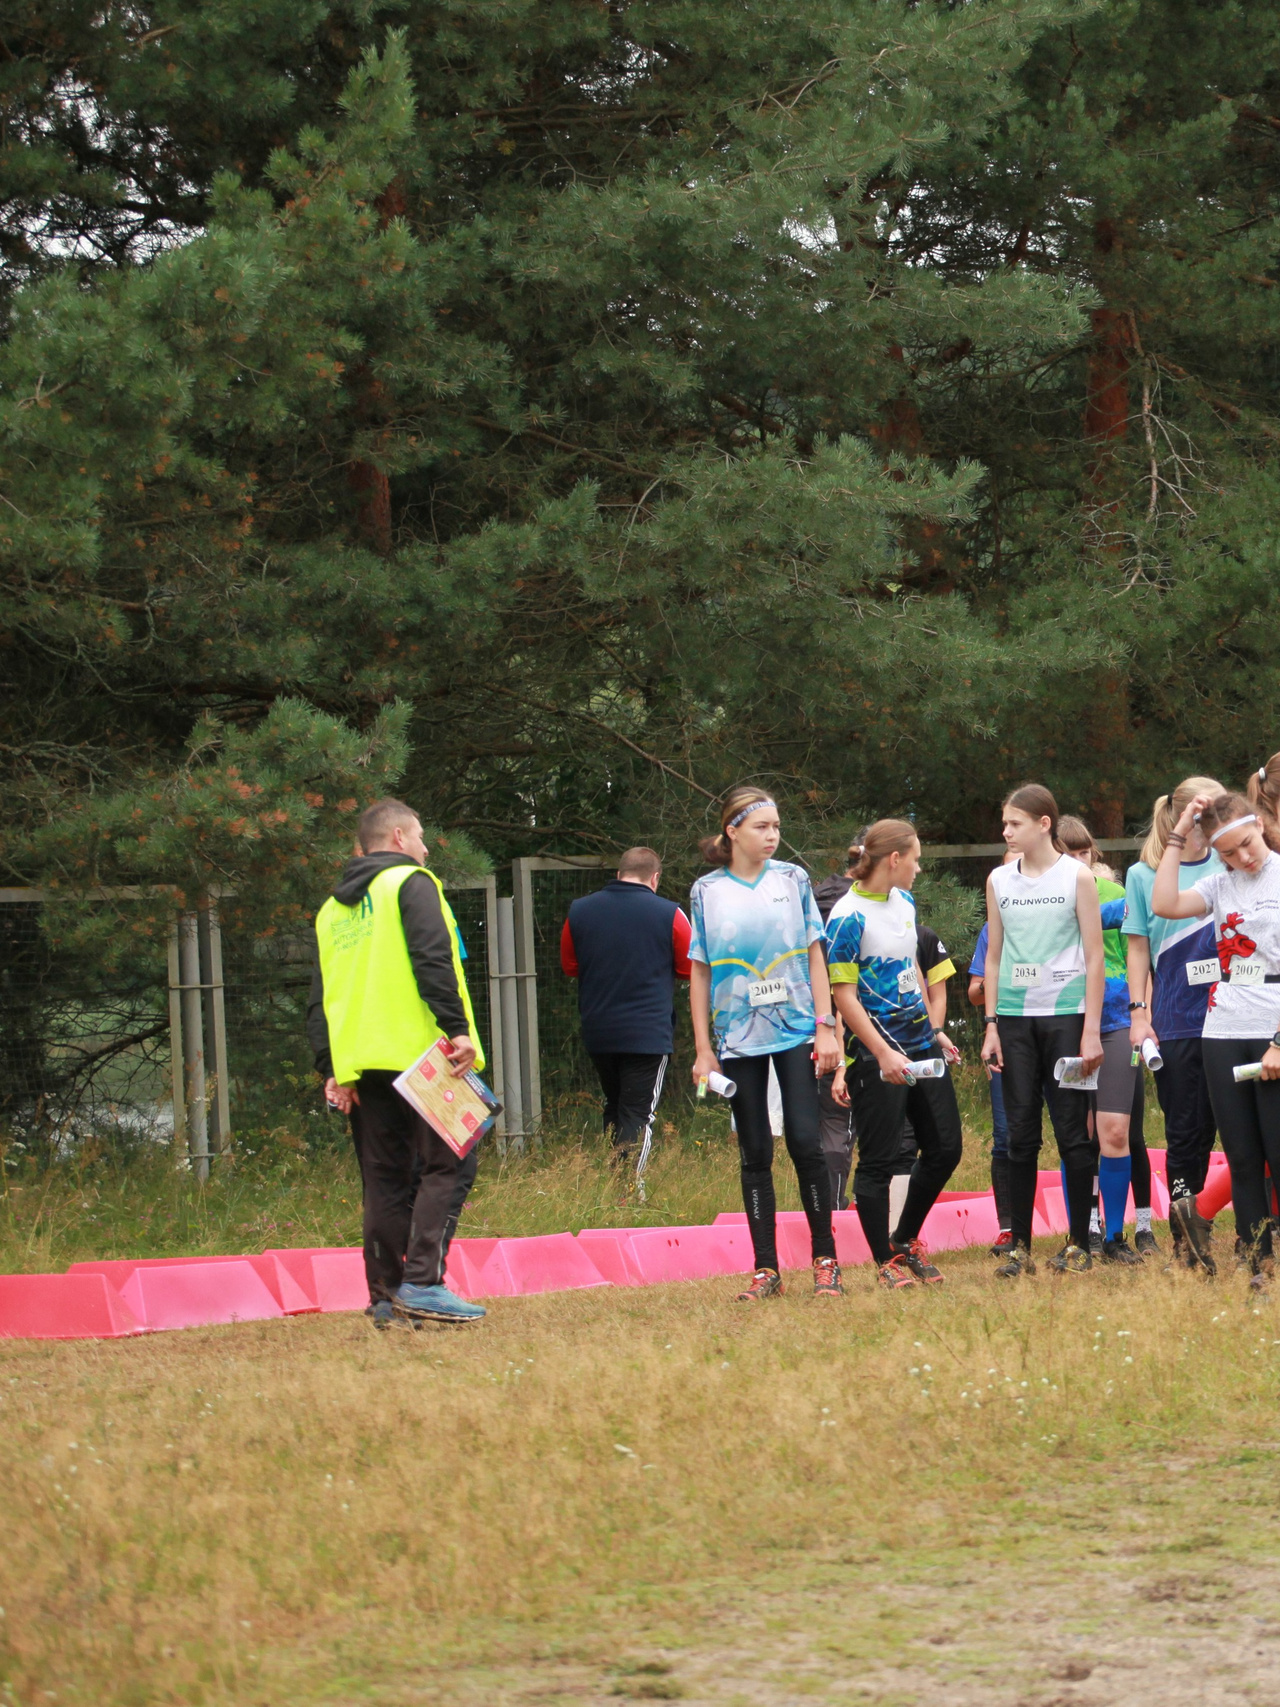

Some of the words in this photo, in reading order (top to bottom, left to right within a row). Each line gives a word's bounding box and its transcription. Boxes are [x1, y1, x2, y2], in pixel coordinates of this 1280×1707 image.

[1012, 896, 1065, 906] RUNWOOD
[1015, 967, 1036, 978] 2034
[1193, 962, 1217, 976] 2027
[1235, 964, 1260, 976] 2007
[755, 982, 781, 997] 2019
